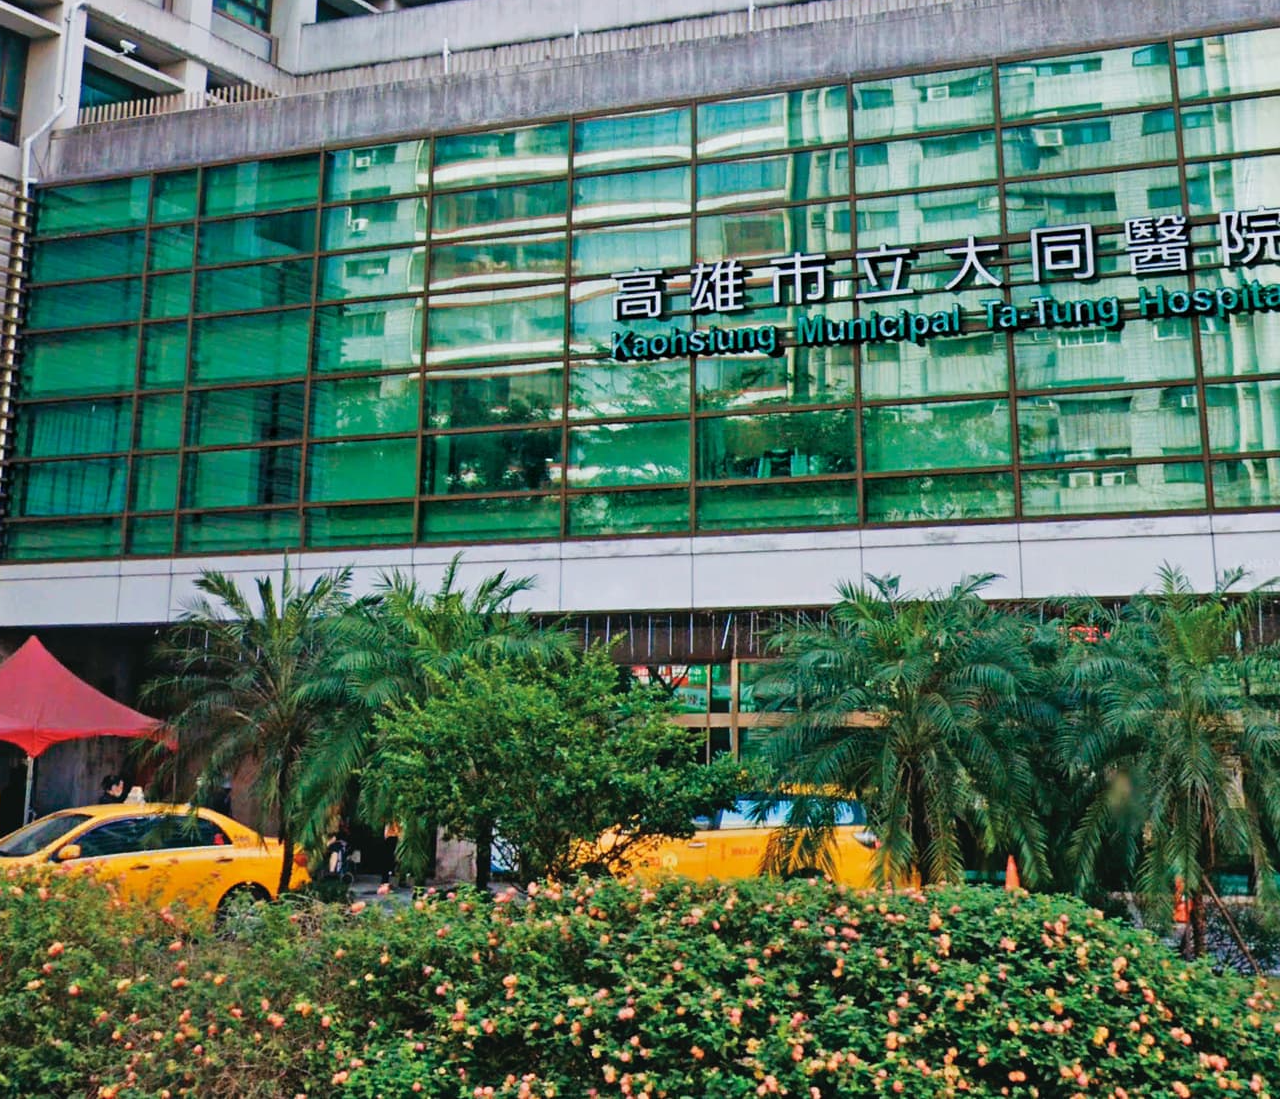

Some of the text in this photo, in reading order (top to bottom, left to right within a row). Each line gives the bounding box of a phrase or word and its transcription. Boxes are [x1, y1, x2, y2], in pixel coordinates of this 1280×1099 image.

[611, 324, 780, 360] Kaohsiung
[795, 302, 962, 344] Municipal
[981, 293, 1122, 332] Ta-Tung
